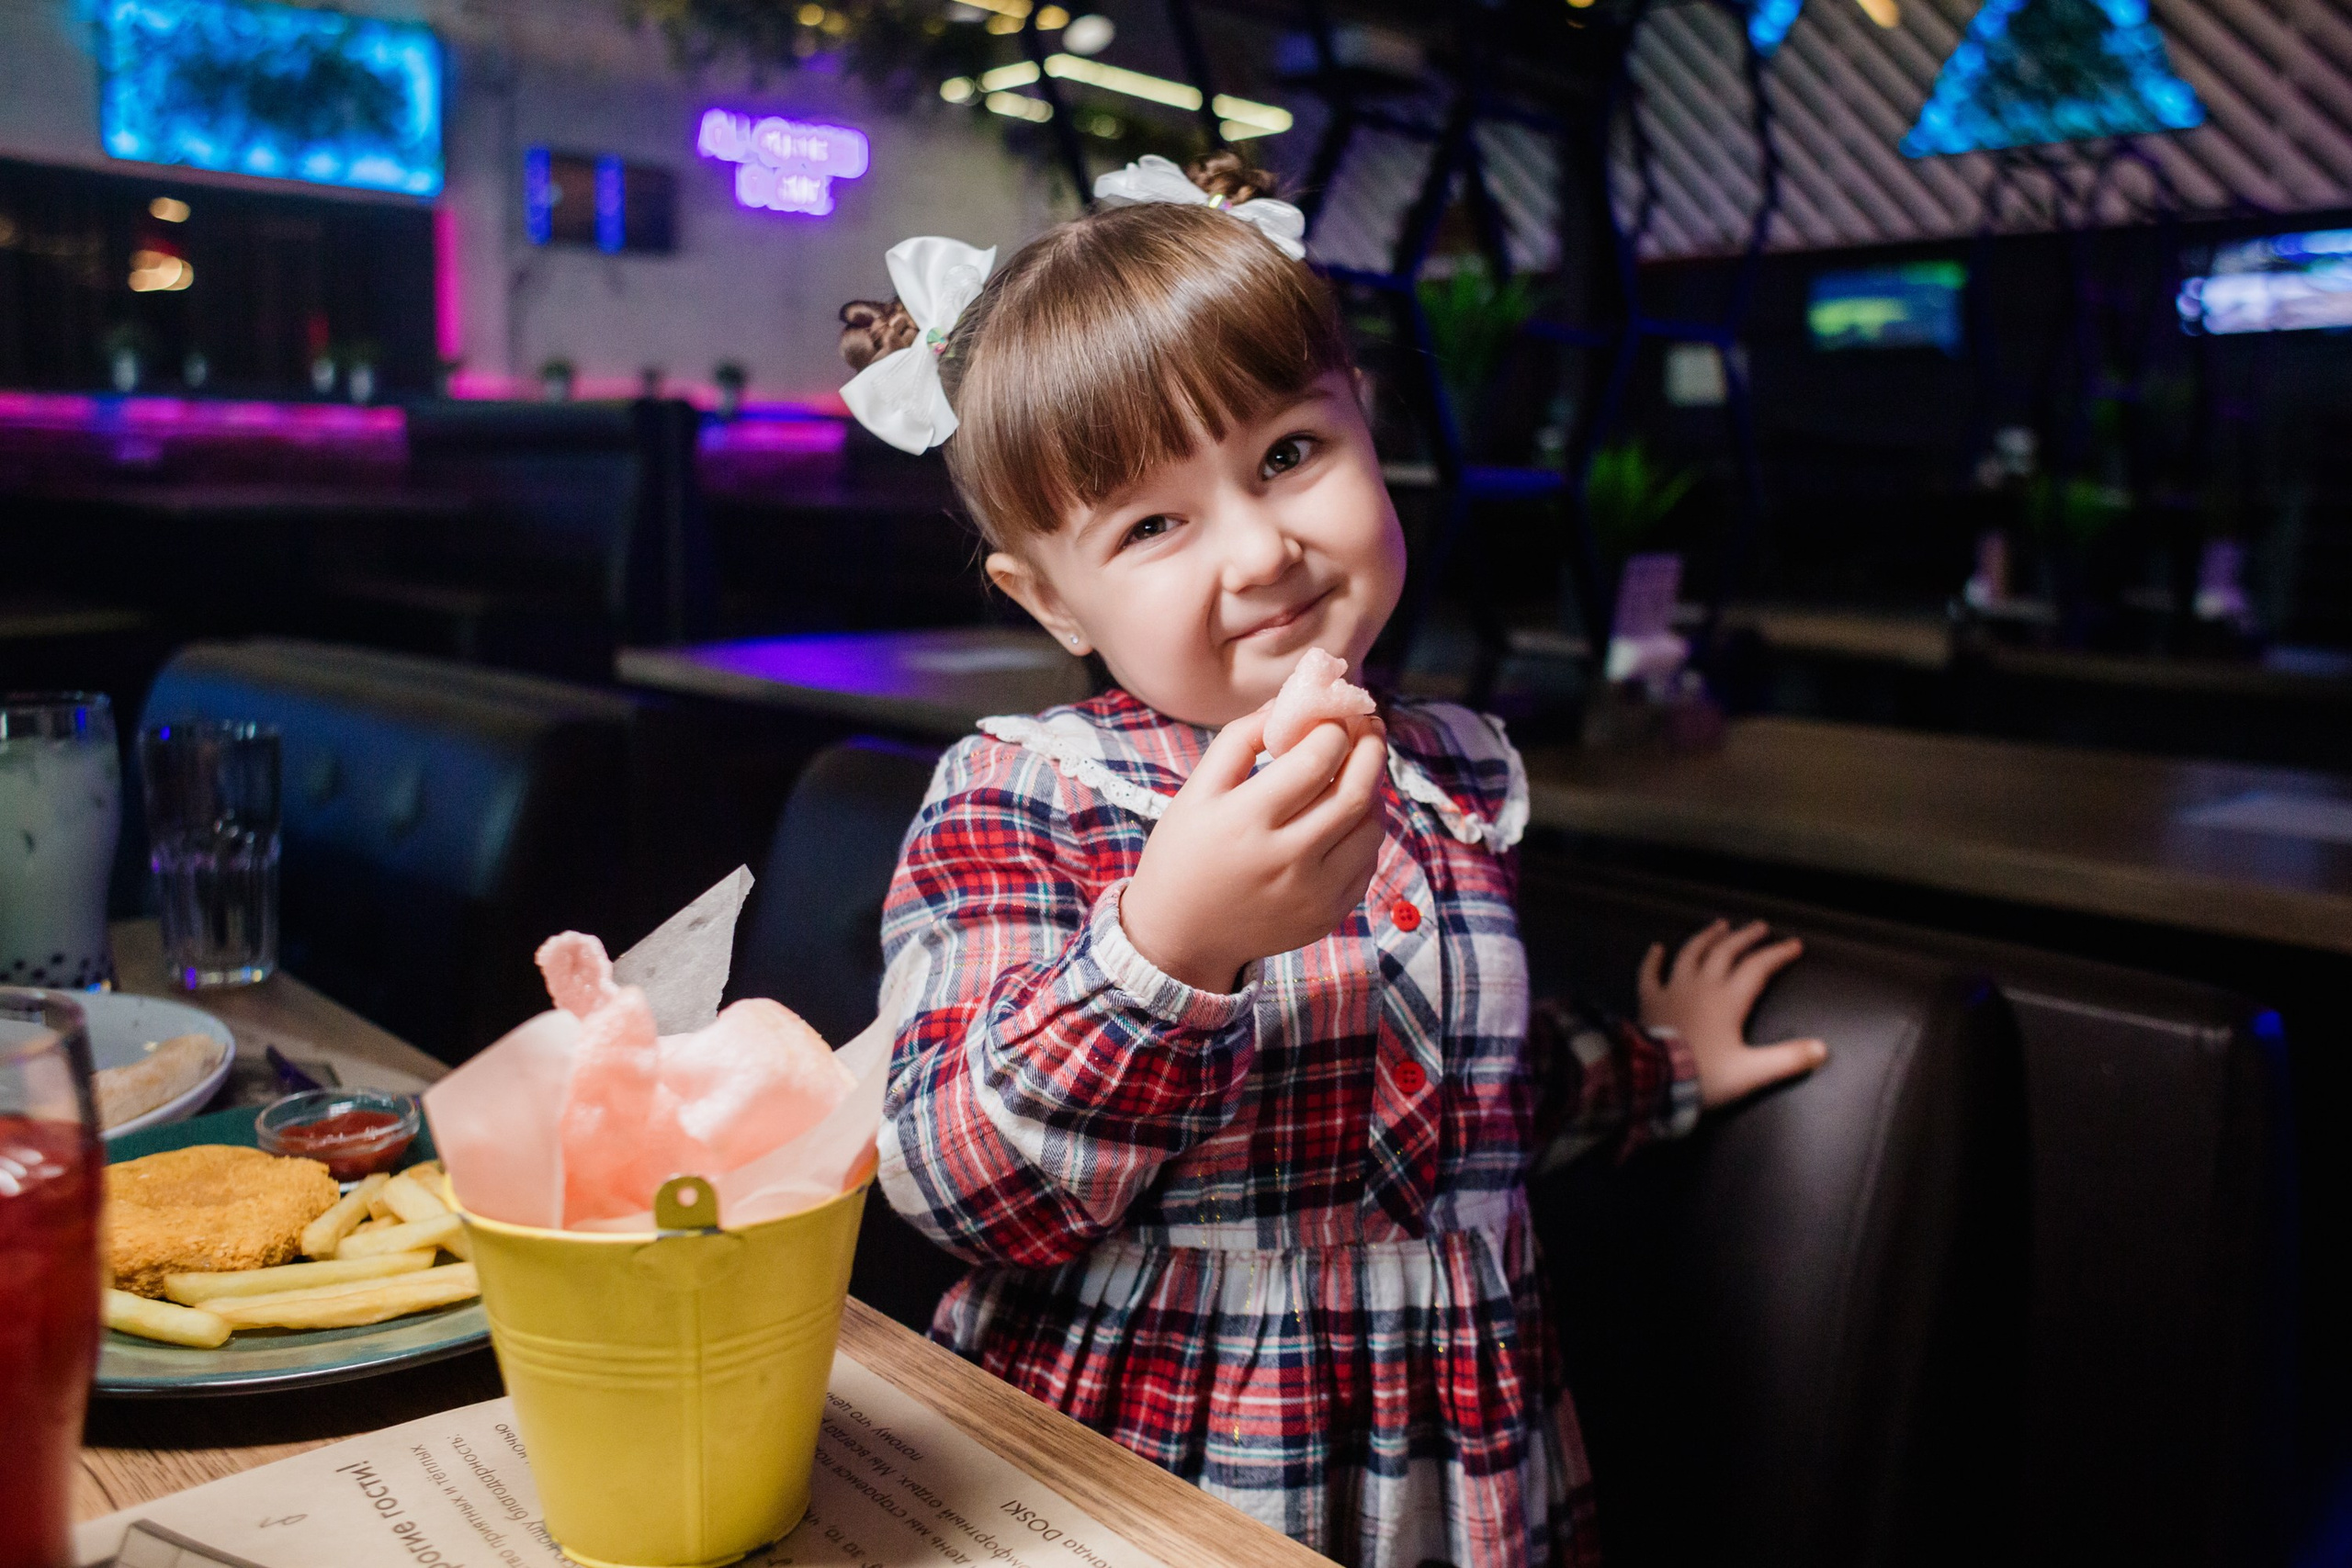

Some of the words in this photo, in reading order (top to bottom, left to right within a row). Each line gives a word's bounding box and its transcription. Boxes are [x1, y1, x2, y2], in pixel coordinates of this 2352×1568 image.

[827, 1392, 853, 1412] цен
[850, 1411, 872, 1428] что
[824, 1425, 872, 1459] всегда
[871, 1427, 924, 1461] потому
[410, 1444, 450, 1486] тёплых
[868, 1456, 894, 1477] Мы
[335, 1460, 406, 1519] гости!
[443, 1485, 458, 1495] и
[832, 1465, 908, 1518] стараемся
[451, 1495, 509, 1549] приятных
[905, 1517, 932, 1537] мы
[1000, 1499, 1064, 1542] DOSKI
[931, 1537, 972, 1565] день
[1062, 1539, 1113, 1568] анда
